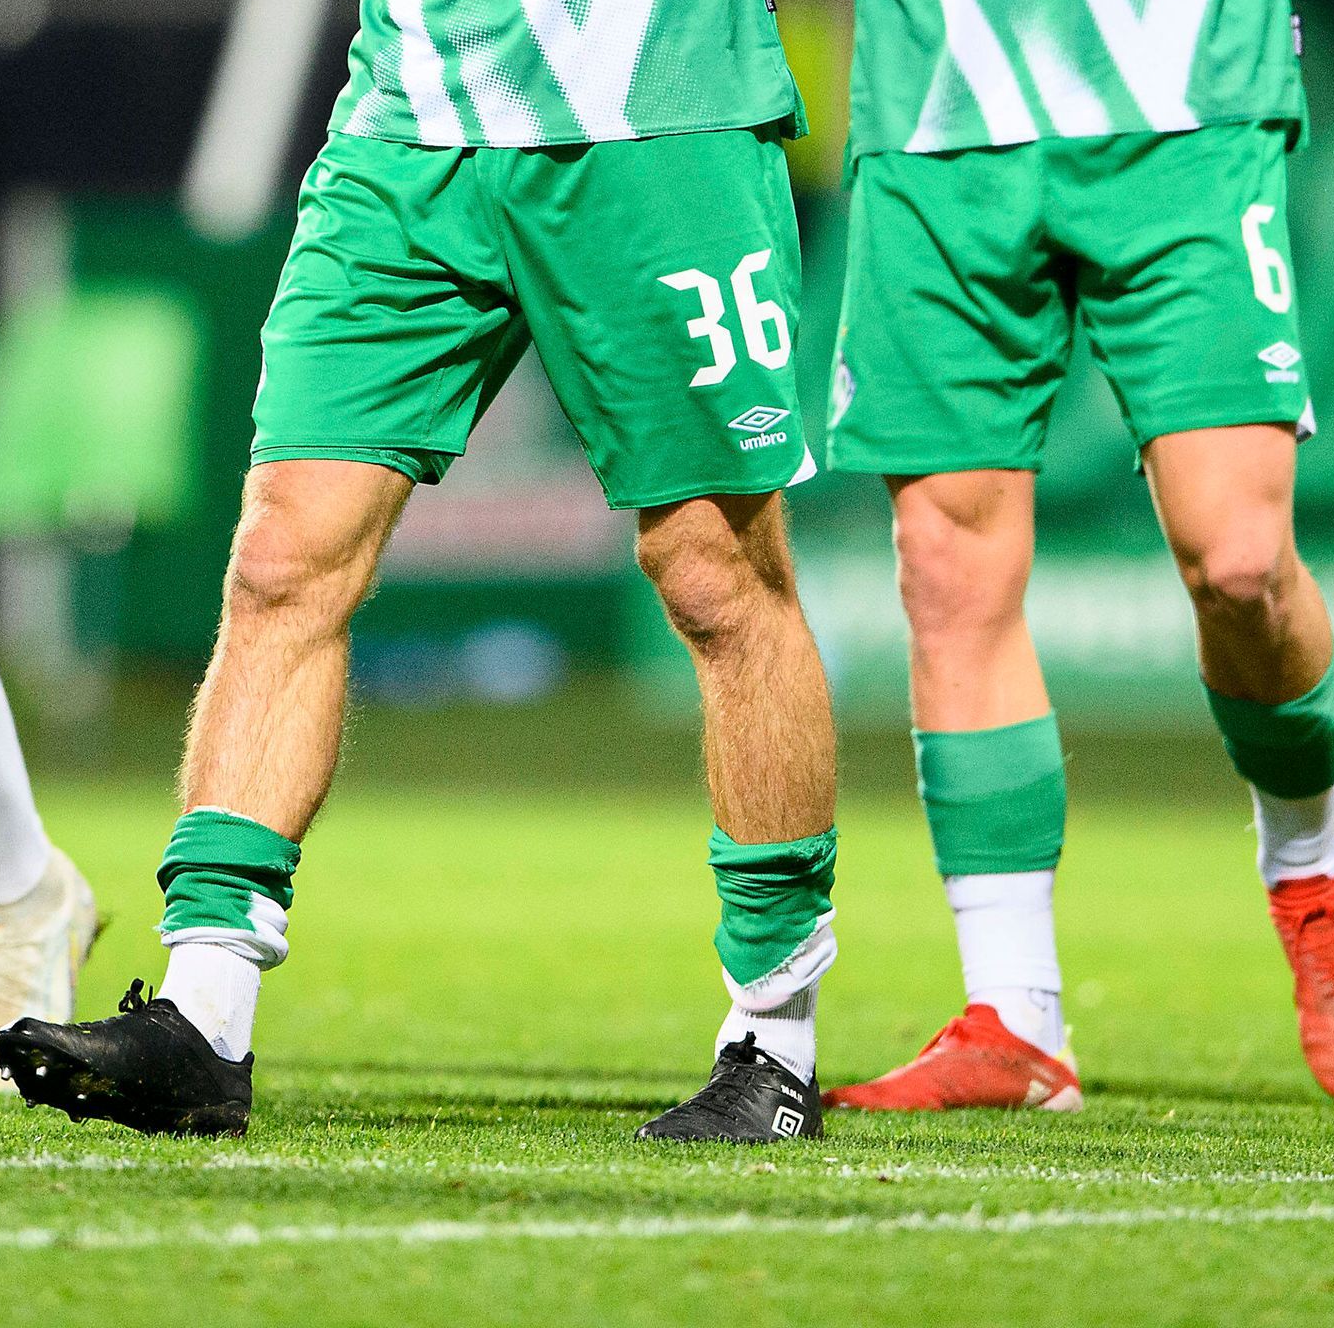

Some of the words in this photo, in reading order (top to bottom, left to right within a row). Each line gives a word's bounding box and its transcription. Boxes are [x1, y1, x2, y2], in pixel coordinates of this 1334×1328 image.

[1241, 204, 1292, 314] 6
[657, 248, 792, 388] 36
[739, 431, 787, 451] umbro
